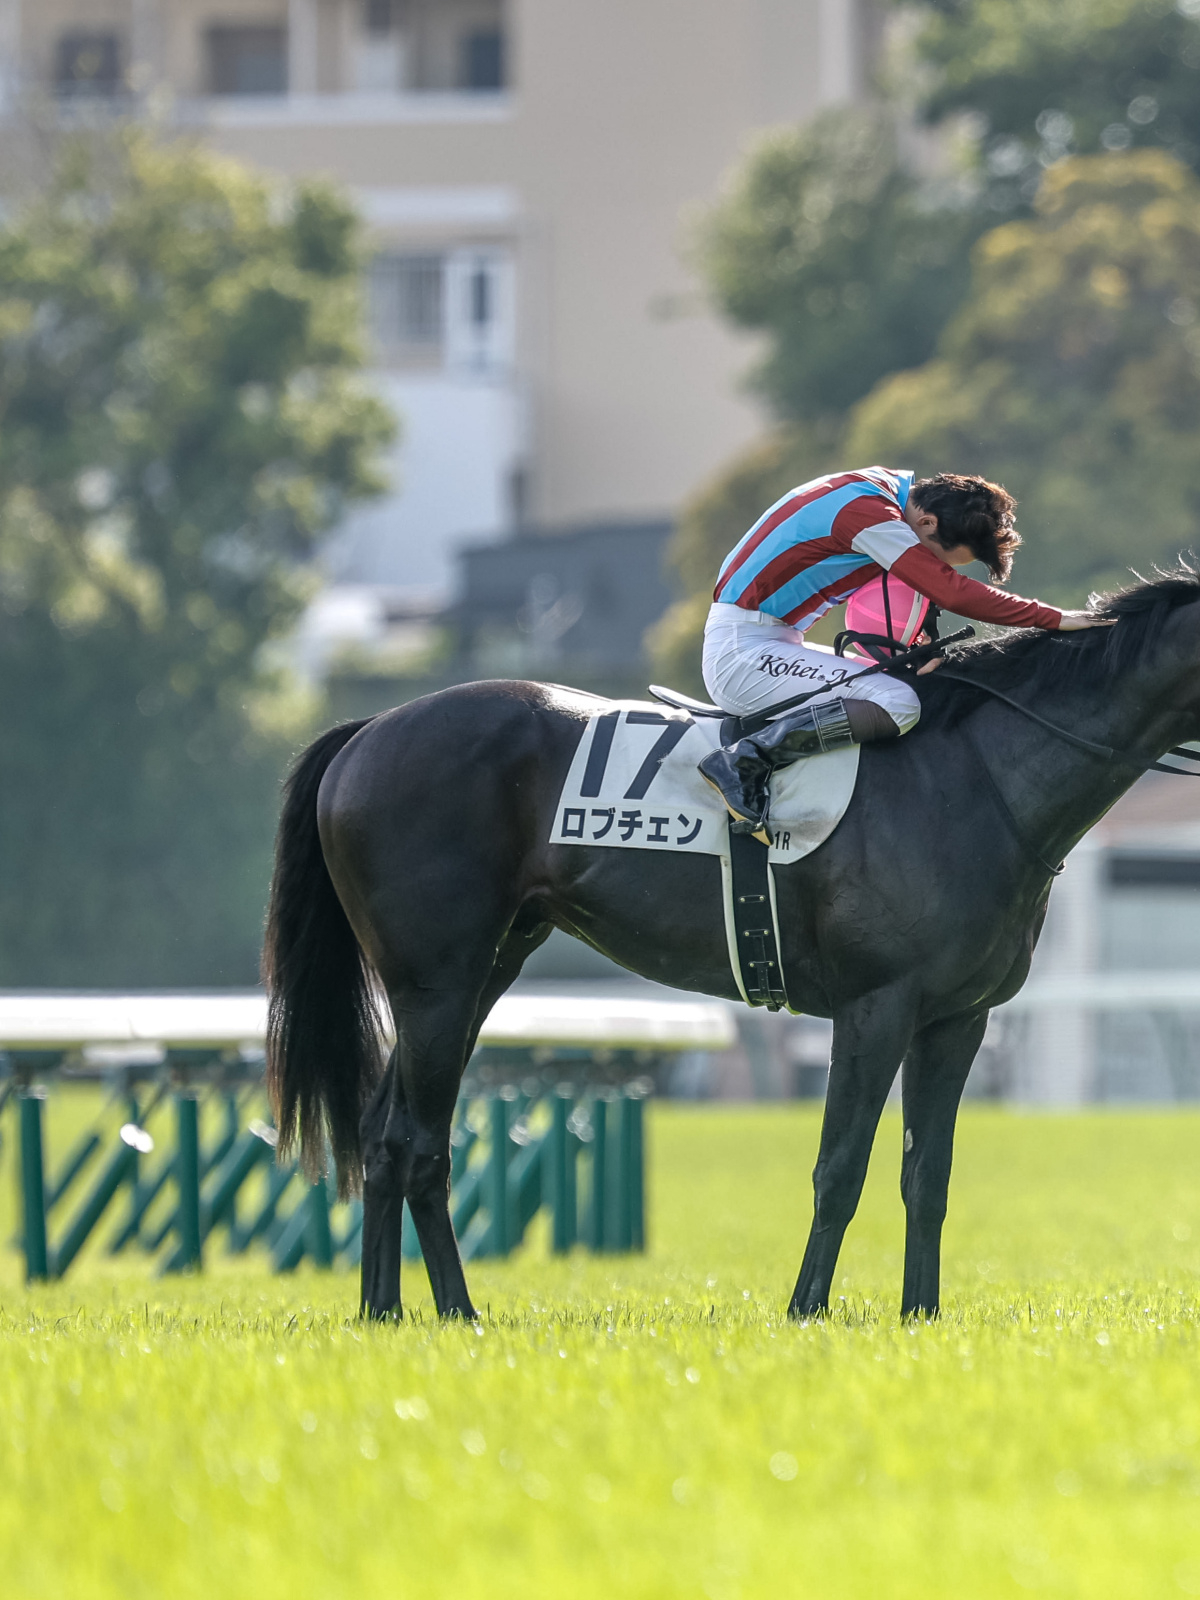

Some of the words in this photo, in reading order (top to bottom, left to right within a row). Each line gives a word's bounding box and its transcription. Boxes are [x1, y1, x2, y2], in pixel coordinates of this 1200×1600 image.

[580, 709, 696, 800] 17
[560, 807, 703, 845] ロブチェン
